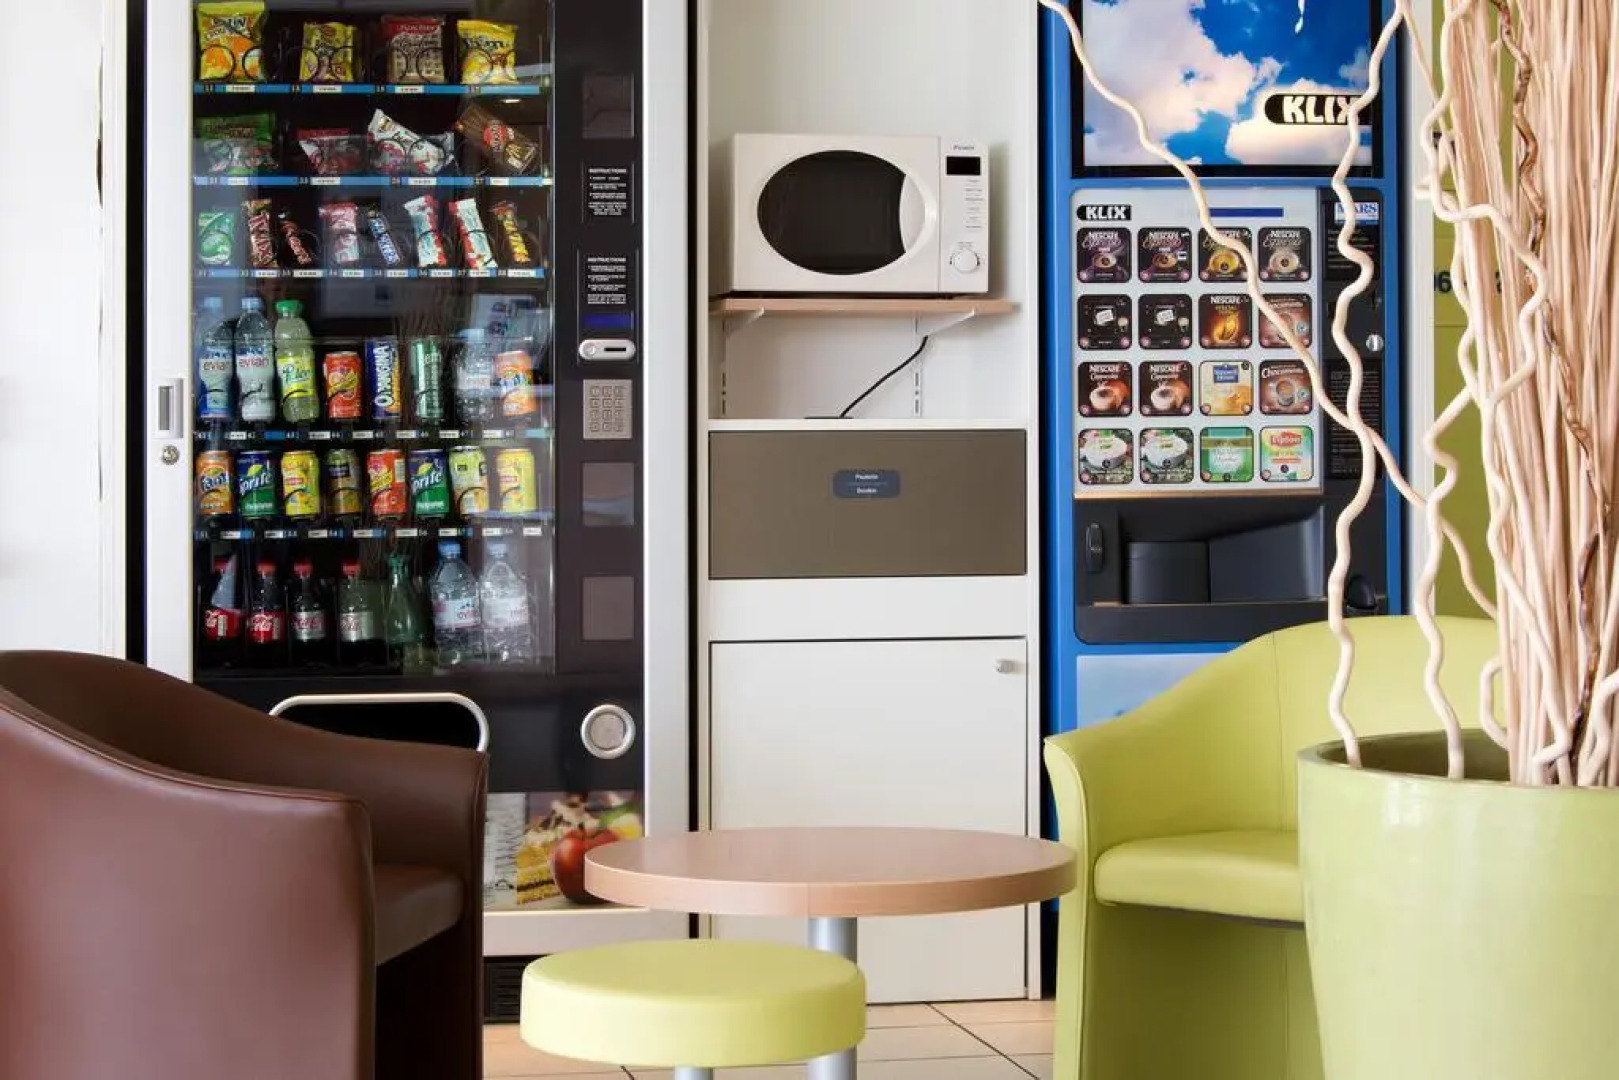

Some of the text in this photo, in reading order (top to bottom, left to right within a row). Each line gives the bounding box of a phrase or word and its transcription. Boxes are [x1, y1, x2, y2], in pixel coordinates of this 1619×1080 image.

[1283, 95, 1359, 123] KLIX
[1086, 206, 1127, 219] KLIX
[239, 357, 269, 368] evian
